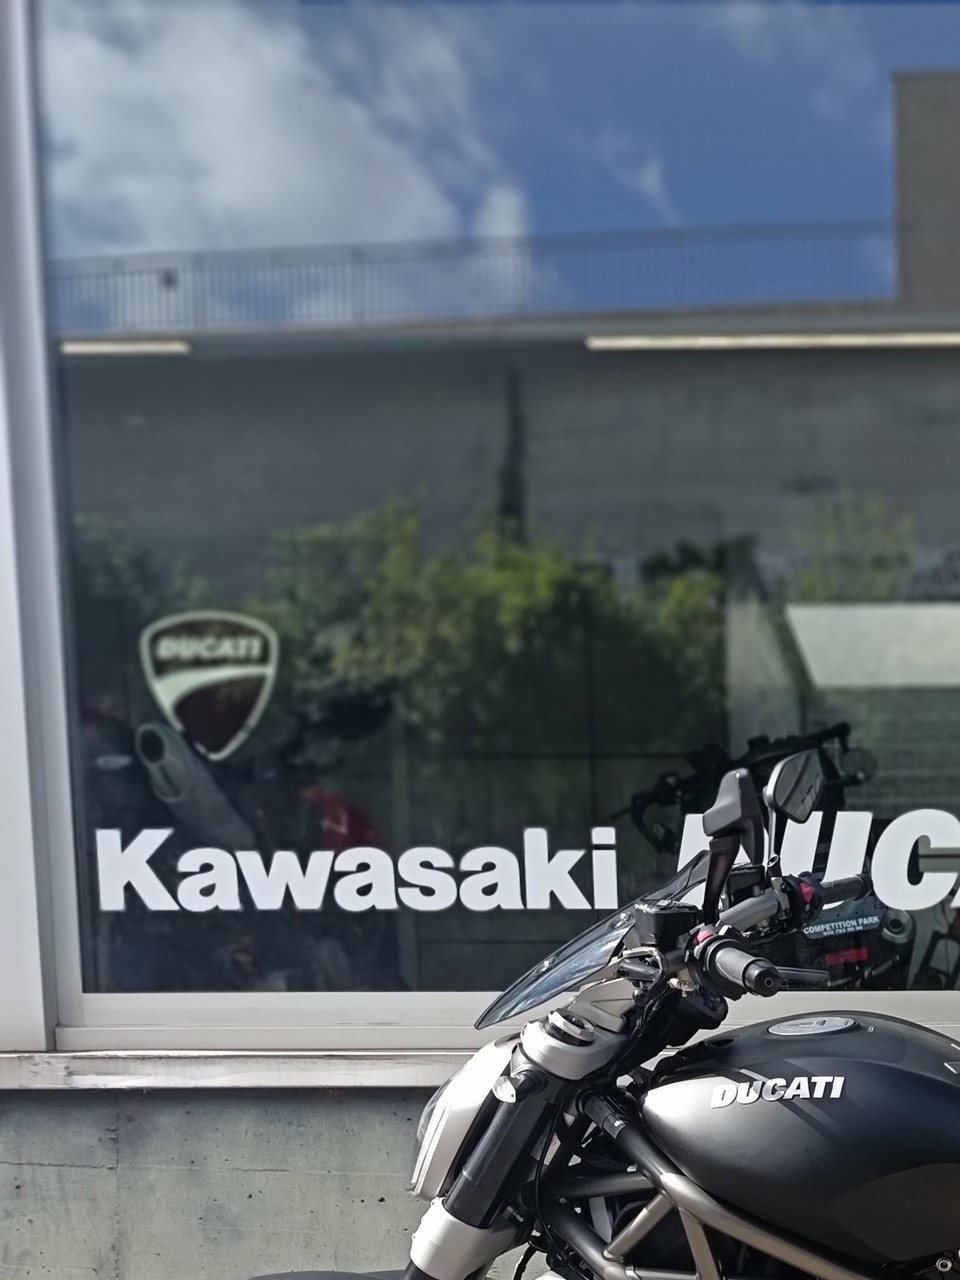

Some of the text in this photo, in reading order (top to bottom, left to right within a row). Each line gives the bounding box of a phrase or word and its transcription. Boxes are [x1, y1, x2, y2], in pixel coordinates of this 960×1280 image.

[156, 635, 262, 660] DUCATI
[95, 826, 619, 912] Kawasaki
[803, 919, 857, 935] COMPETITION
[858, 915, 880, 926] PARK
[710, 1076, 846, 1109] DUCATI
